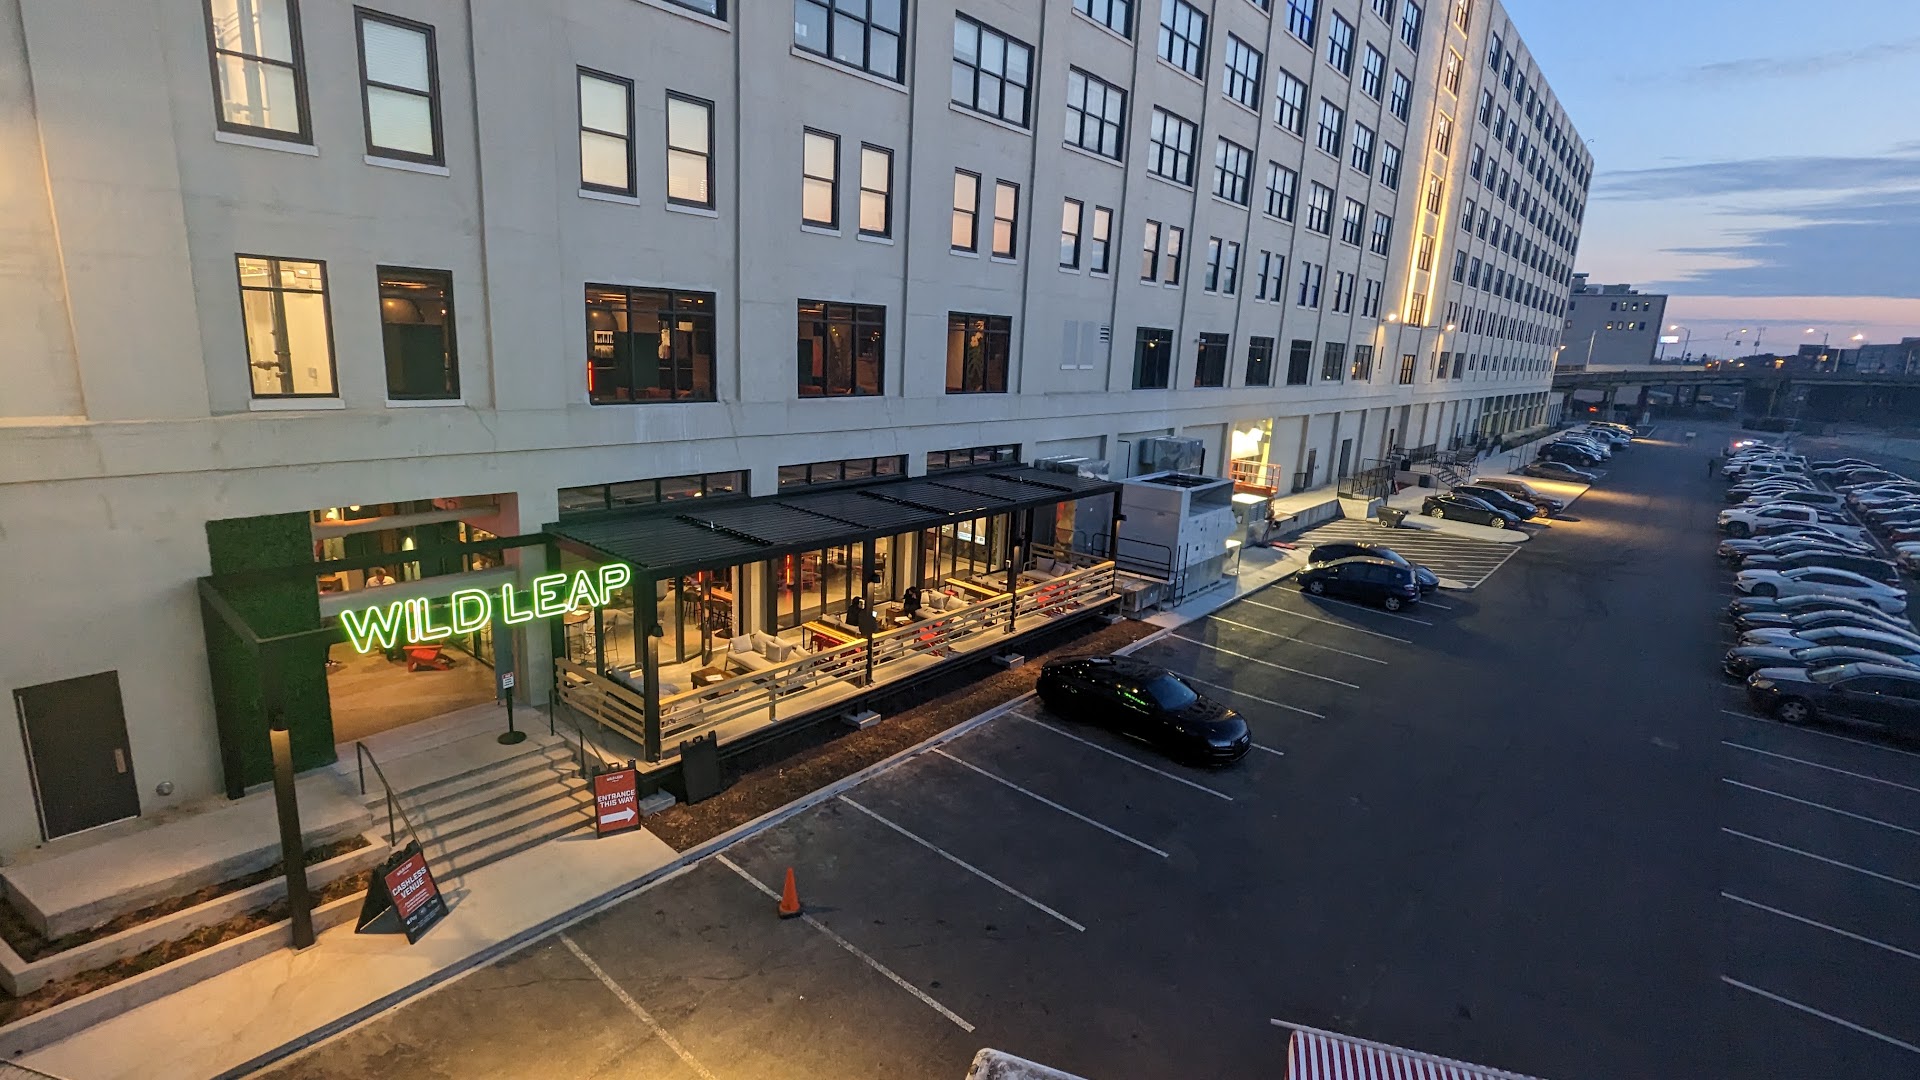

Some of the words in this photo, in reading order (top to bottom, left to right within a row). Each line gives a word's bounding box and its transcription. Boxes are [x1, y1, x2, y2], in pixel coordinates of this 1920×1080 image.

[340, 588, 492, 654] WILD
[502, 563, 631, 625] LEAP
[597, 789, 635, 803] ENTRANCE
[599, 799, 617, 808] THIS
[618, 796, 634, 804] WAY
[392, 866, 427, 897] CASHLESS
[400, 877, 425, 899] VENUE
